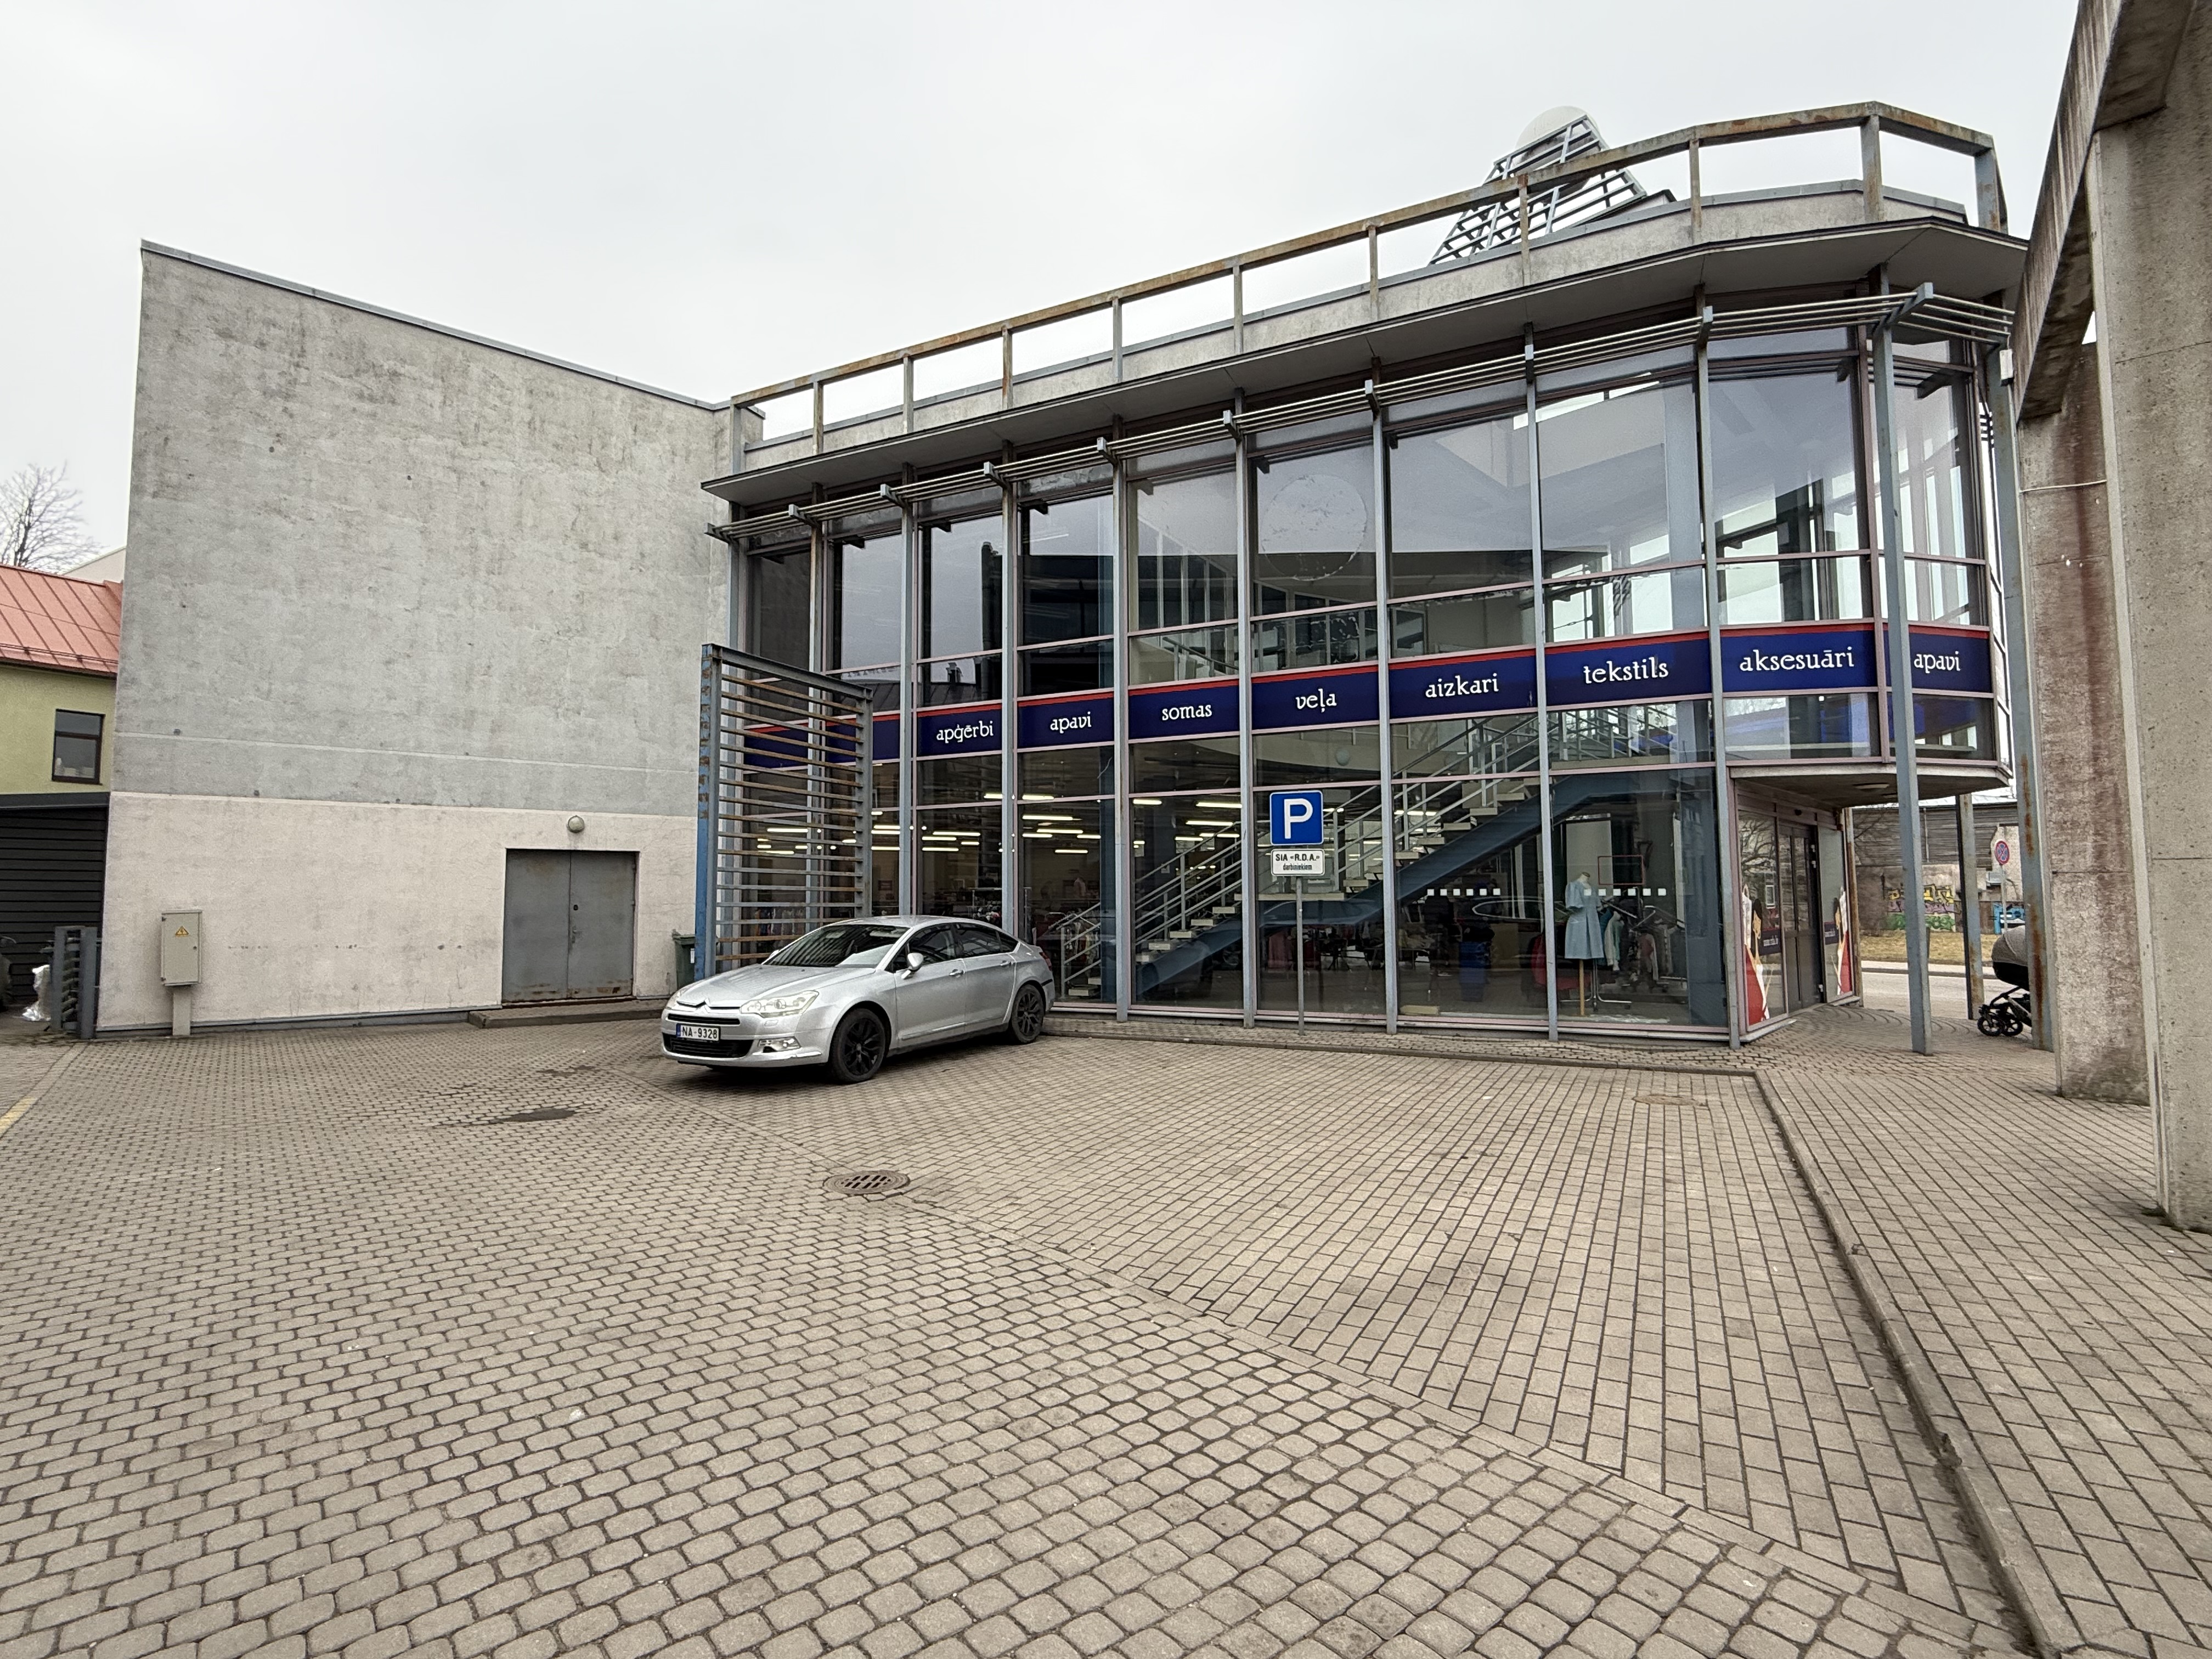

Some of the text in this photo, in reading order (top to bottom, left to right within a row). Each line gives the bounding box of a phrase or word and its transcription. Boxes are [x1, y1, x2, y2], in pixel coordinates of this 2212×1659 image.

[1583, 656, 1669, 684] tekstils
[1739, 646, 1854, 672] aksesuāri
[1913, 651, 1961, 673] apavi
[1425, 673, 1499, 698] aizkari
[1162, 704, 1212, 721] somas
[1295, 688, 1337, 713] veļa
[936, 720, 994, 743] apģērbi
[1050, 711, 1092, 734] apavi
[1284, 798, 1313, 839] P
[682, 1026, 718, 1039] NA-9328
